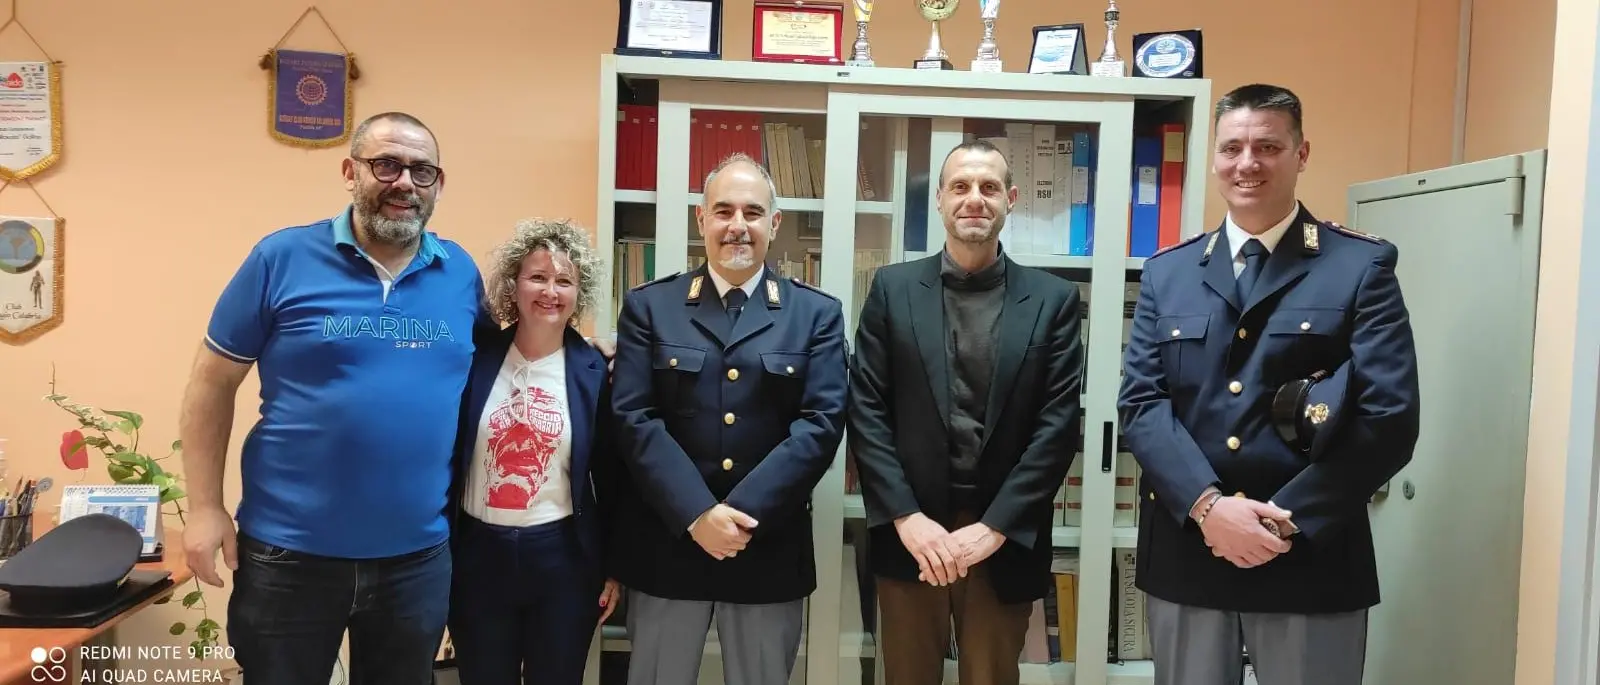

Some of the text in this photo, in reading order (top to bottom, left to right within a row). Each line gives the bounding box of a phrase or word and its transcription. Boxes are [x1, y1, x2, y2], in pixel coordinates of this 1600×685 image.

[1037, 189, 1052, 199] RSU
[323, 315, 455, 342] MARINA
[395, 340, 432, 349] SPORT
[1123, 619, 1137, 652] SICURA
